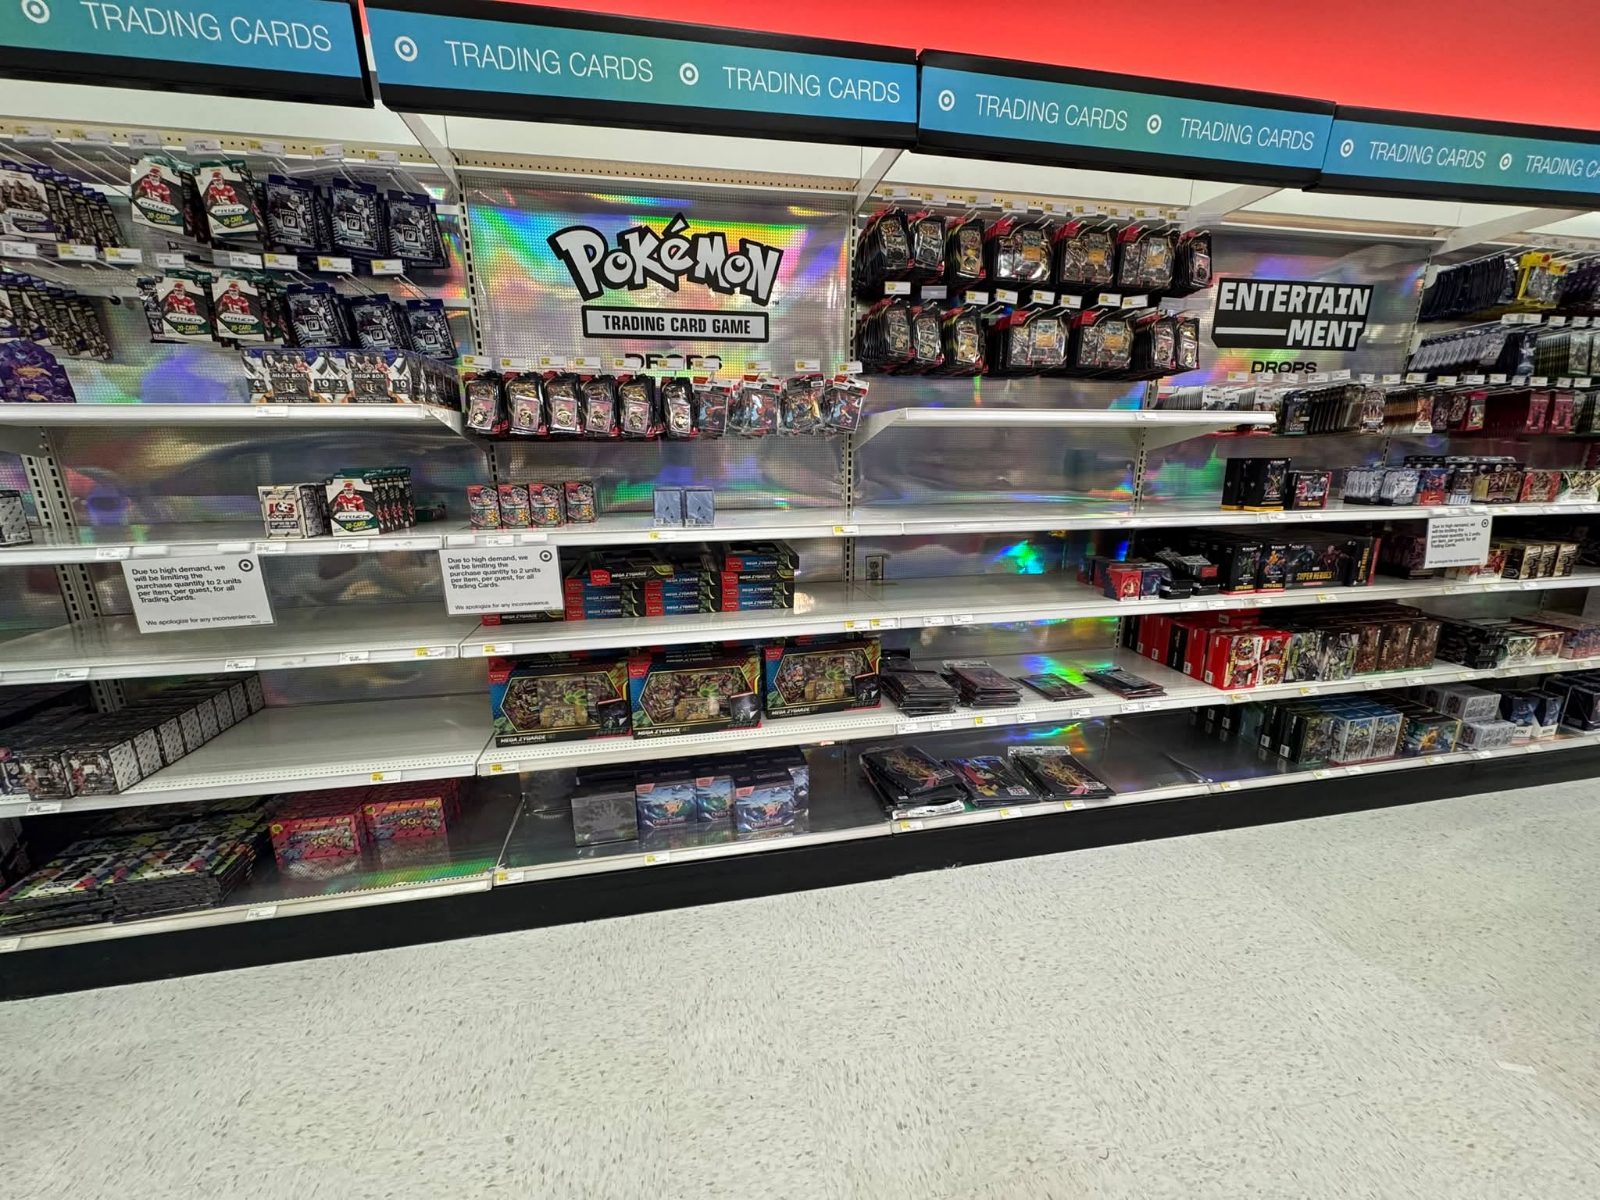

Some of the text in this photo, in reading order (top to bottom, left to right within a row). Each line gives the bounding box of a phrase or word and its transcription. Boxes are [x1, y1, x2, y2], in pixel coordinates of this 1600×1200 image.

[80, 1, 332, 52] TRADING CARDS
[444, 40, 653, 83] TRADING CARDS
[722, 66, 901, 104] TRADING CARDS
[975, 93, 1128, 132] TRADING CARDS
[1179, 117, 1315, 152] TRADING CARDS
[1368, 140, 1487, 170] TRADING CARDS
[1525, 155, 1584, 177] TRADING
[1218, 282, 1371, 316] ENTERTAIN
[602, 314, 751, 334] TRADING CARD GAME
[1286, 319, 1364, 348] MENT
[1251, 361, 1317, 374] DROPS
[159, 566, 177, 574] high
[179, 565, 212, 573] demand,
[160, 573, 189, 581] limiting
[136, 582, 172, 590] purchase
[174, 580, 205, 589] quantity
[188, 587, 212, 595] guest,
[140, 594, 196, 604] Trading Cards.
